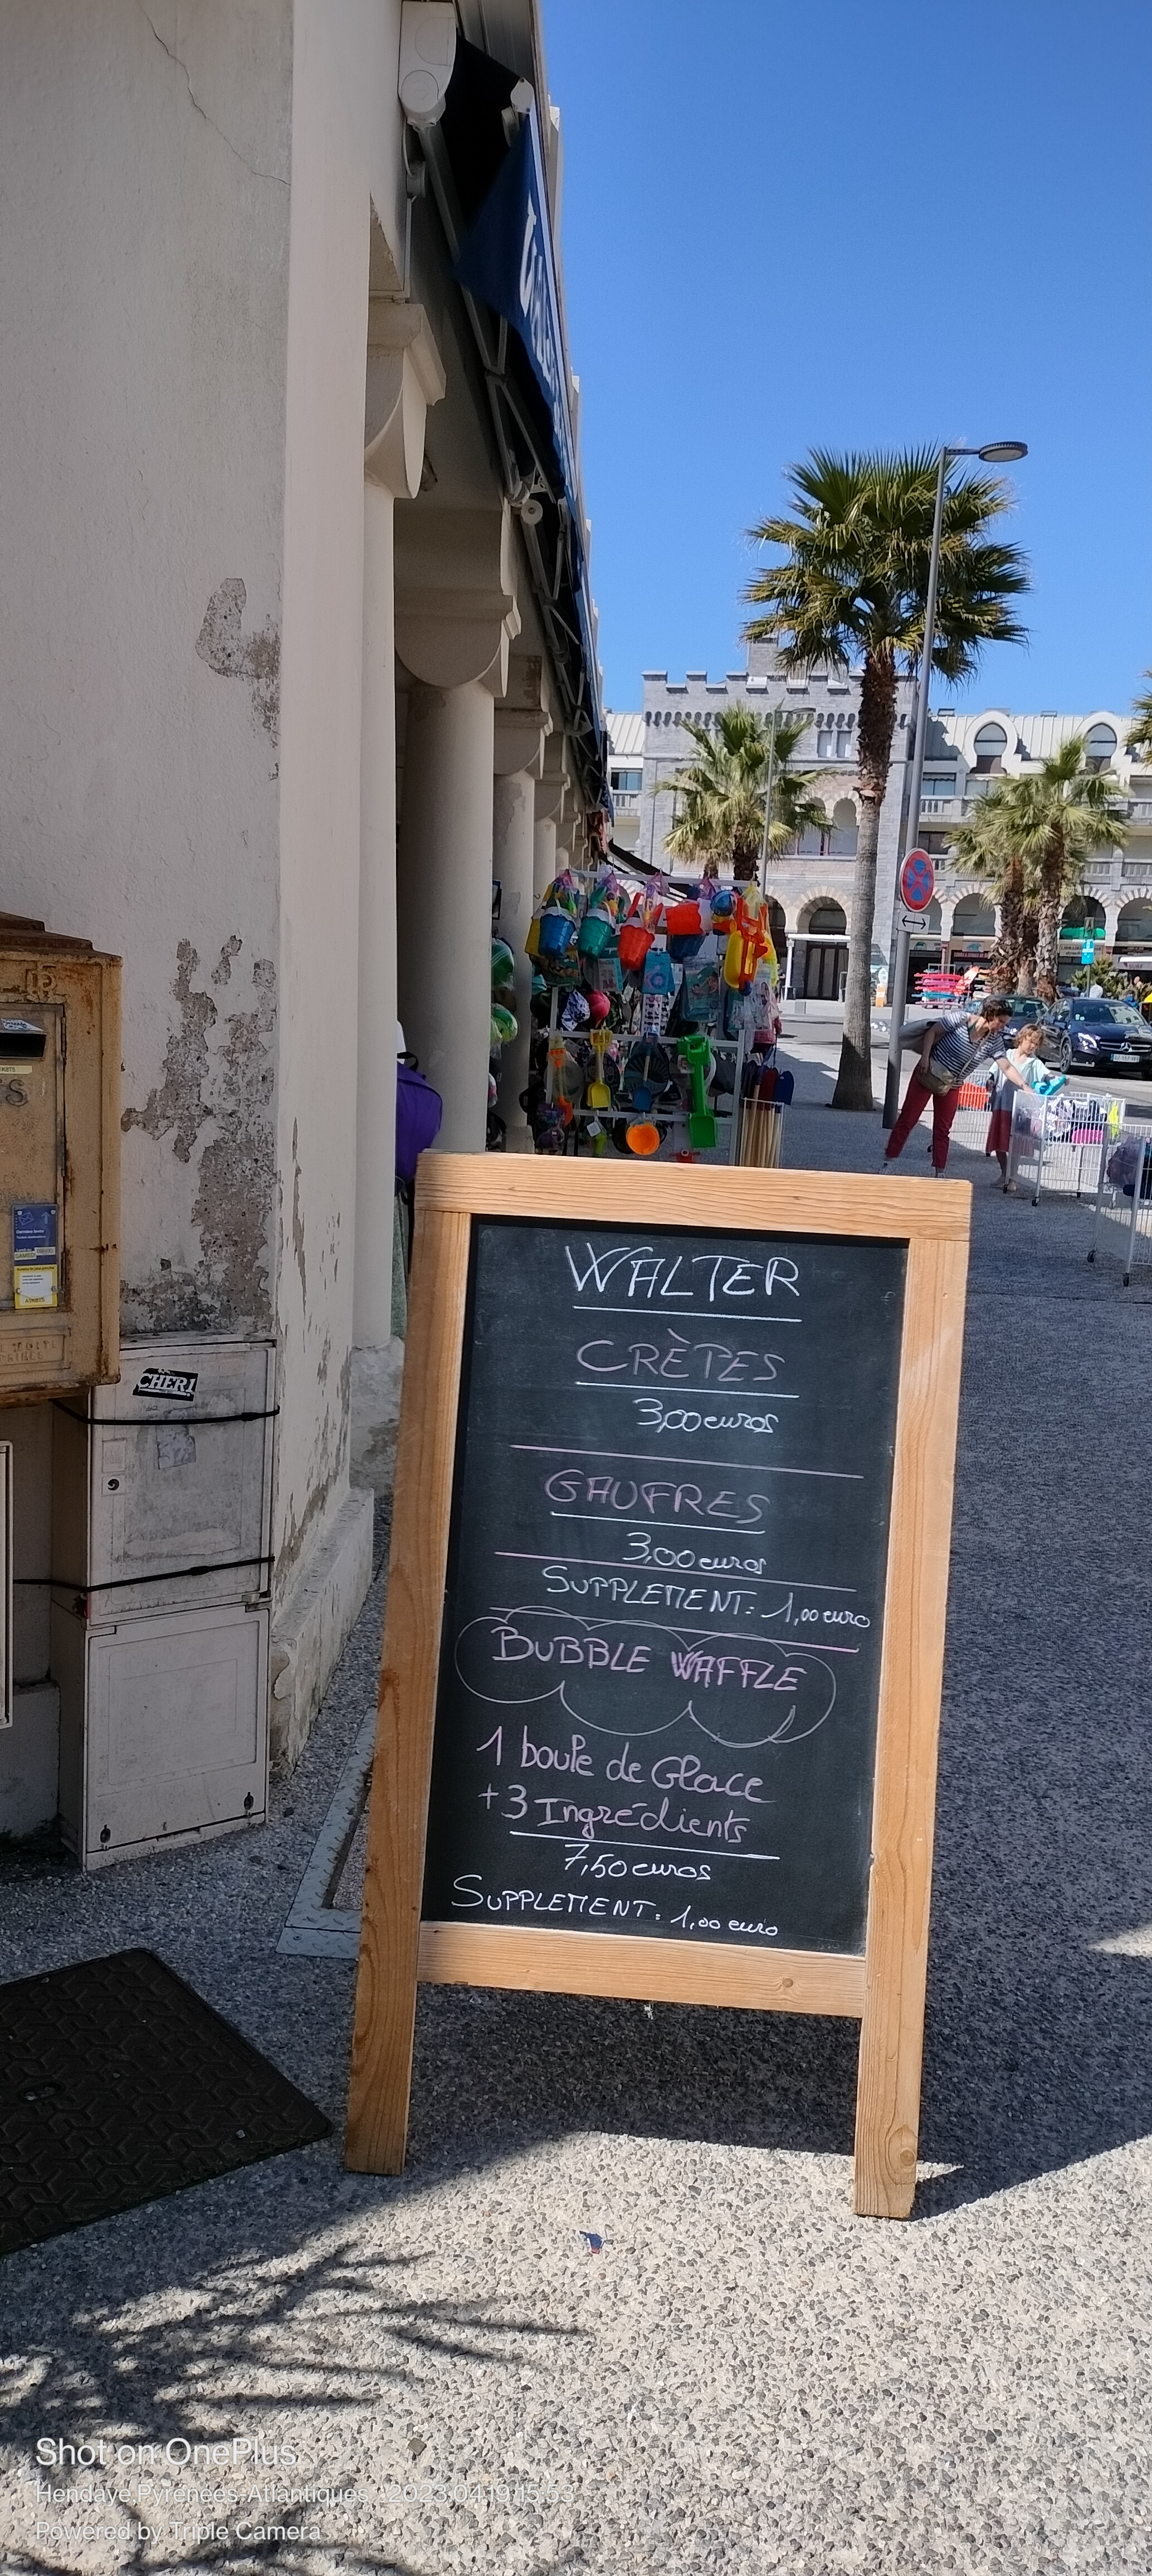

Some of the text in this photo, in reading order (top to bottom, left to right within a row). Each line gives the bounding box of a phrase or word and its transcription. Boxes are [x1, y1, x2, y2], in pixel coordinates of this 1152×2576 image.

[565, 1242, 800, 1302] WALTER
[545, 1468, 770, 1524] GAUFRES
[491, 1626, 807, 1691] BUBBLE WAFFLE
[477, 1725, 778, 1803] 1 boule de Glace
